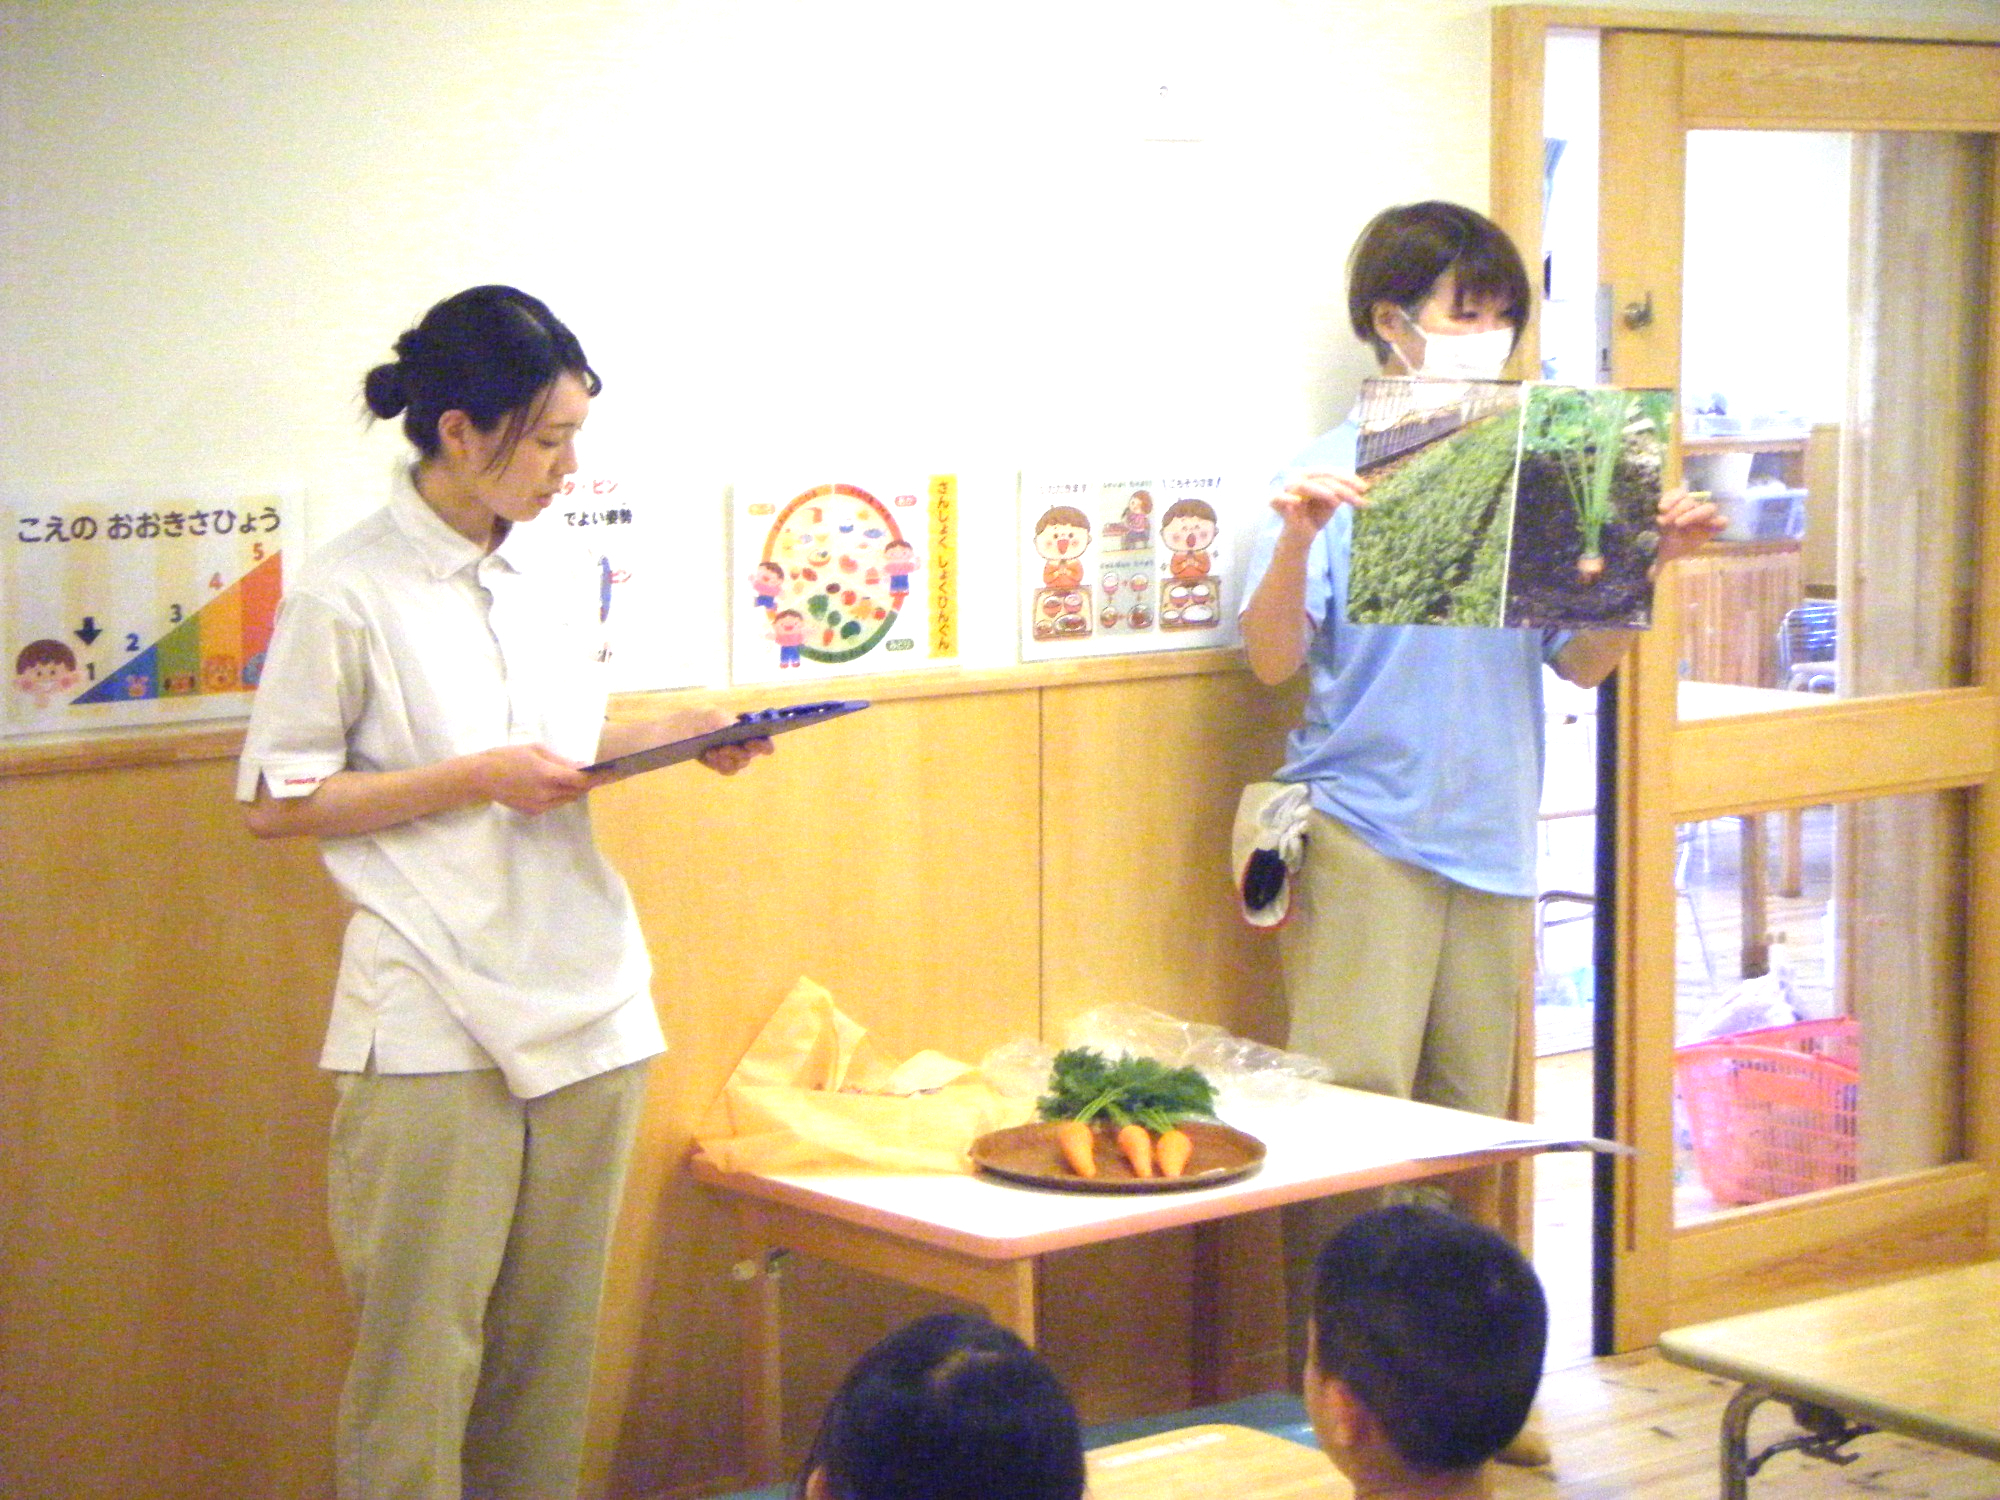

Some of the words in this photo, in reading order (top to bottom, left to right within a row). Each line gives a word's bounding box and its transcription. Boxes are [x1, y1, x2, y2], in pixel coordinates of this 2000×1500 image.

[17, 515, 98, 543] こえの
[107, 507, 281, 540] おおきさひょう
[253, 542, 264, 561] 5
[208, 572, 223, 590] 4
[170, 603, 183, 623] 3
[126, 633, 140, 652] 2
[86, 662, 95, 681] 1
